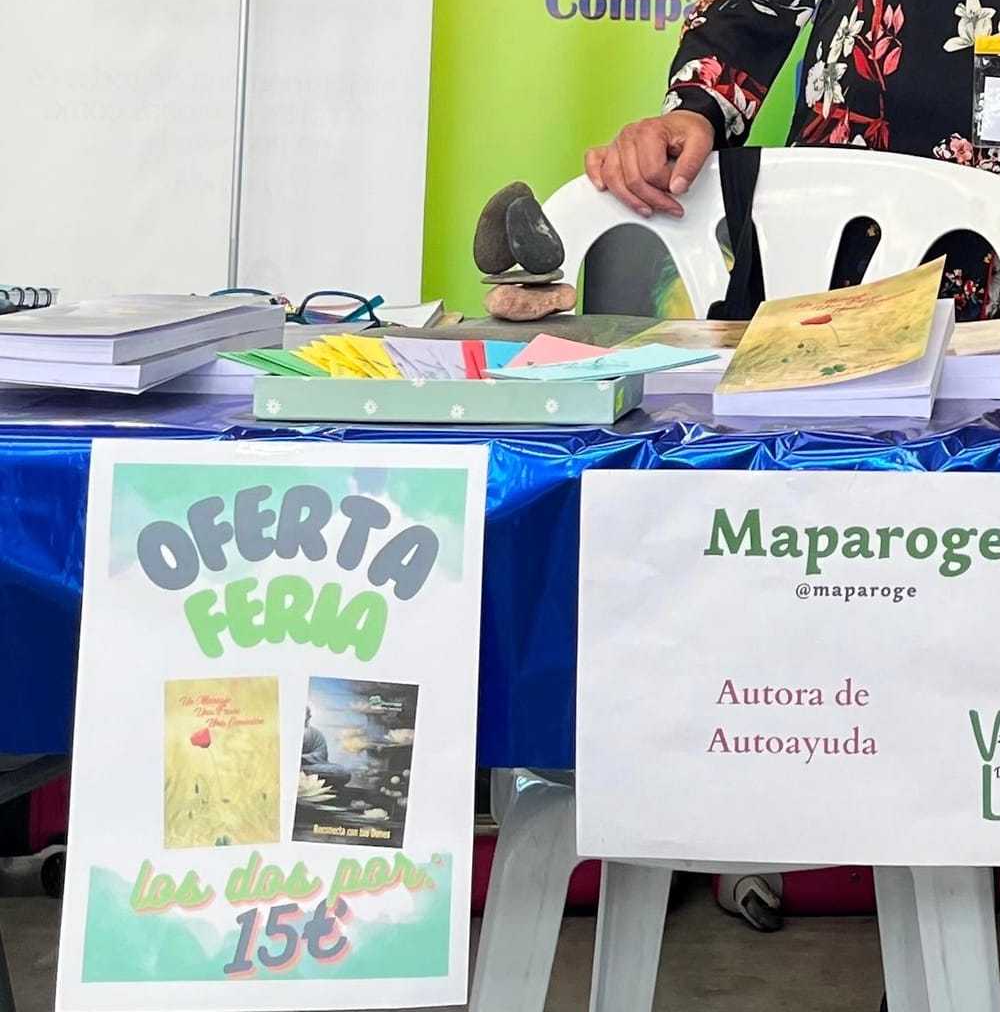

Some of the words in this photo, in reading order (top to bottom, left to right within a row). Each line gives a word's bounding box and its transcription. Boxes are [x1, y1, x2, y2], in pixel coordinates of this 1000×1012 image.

[136, 484, 439, 601] OFERTA
[183, 574, 388, 662] FERIA
[794, 582, 917, 603] @maparoge
[715, 678, 825, 707] Autora
[834, 678, 871, 707] de
[706, 726, 879, 764] Autoayuda
[225, 850, 321, 902] dos
[223, 895, 351, 978] 15€
